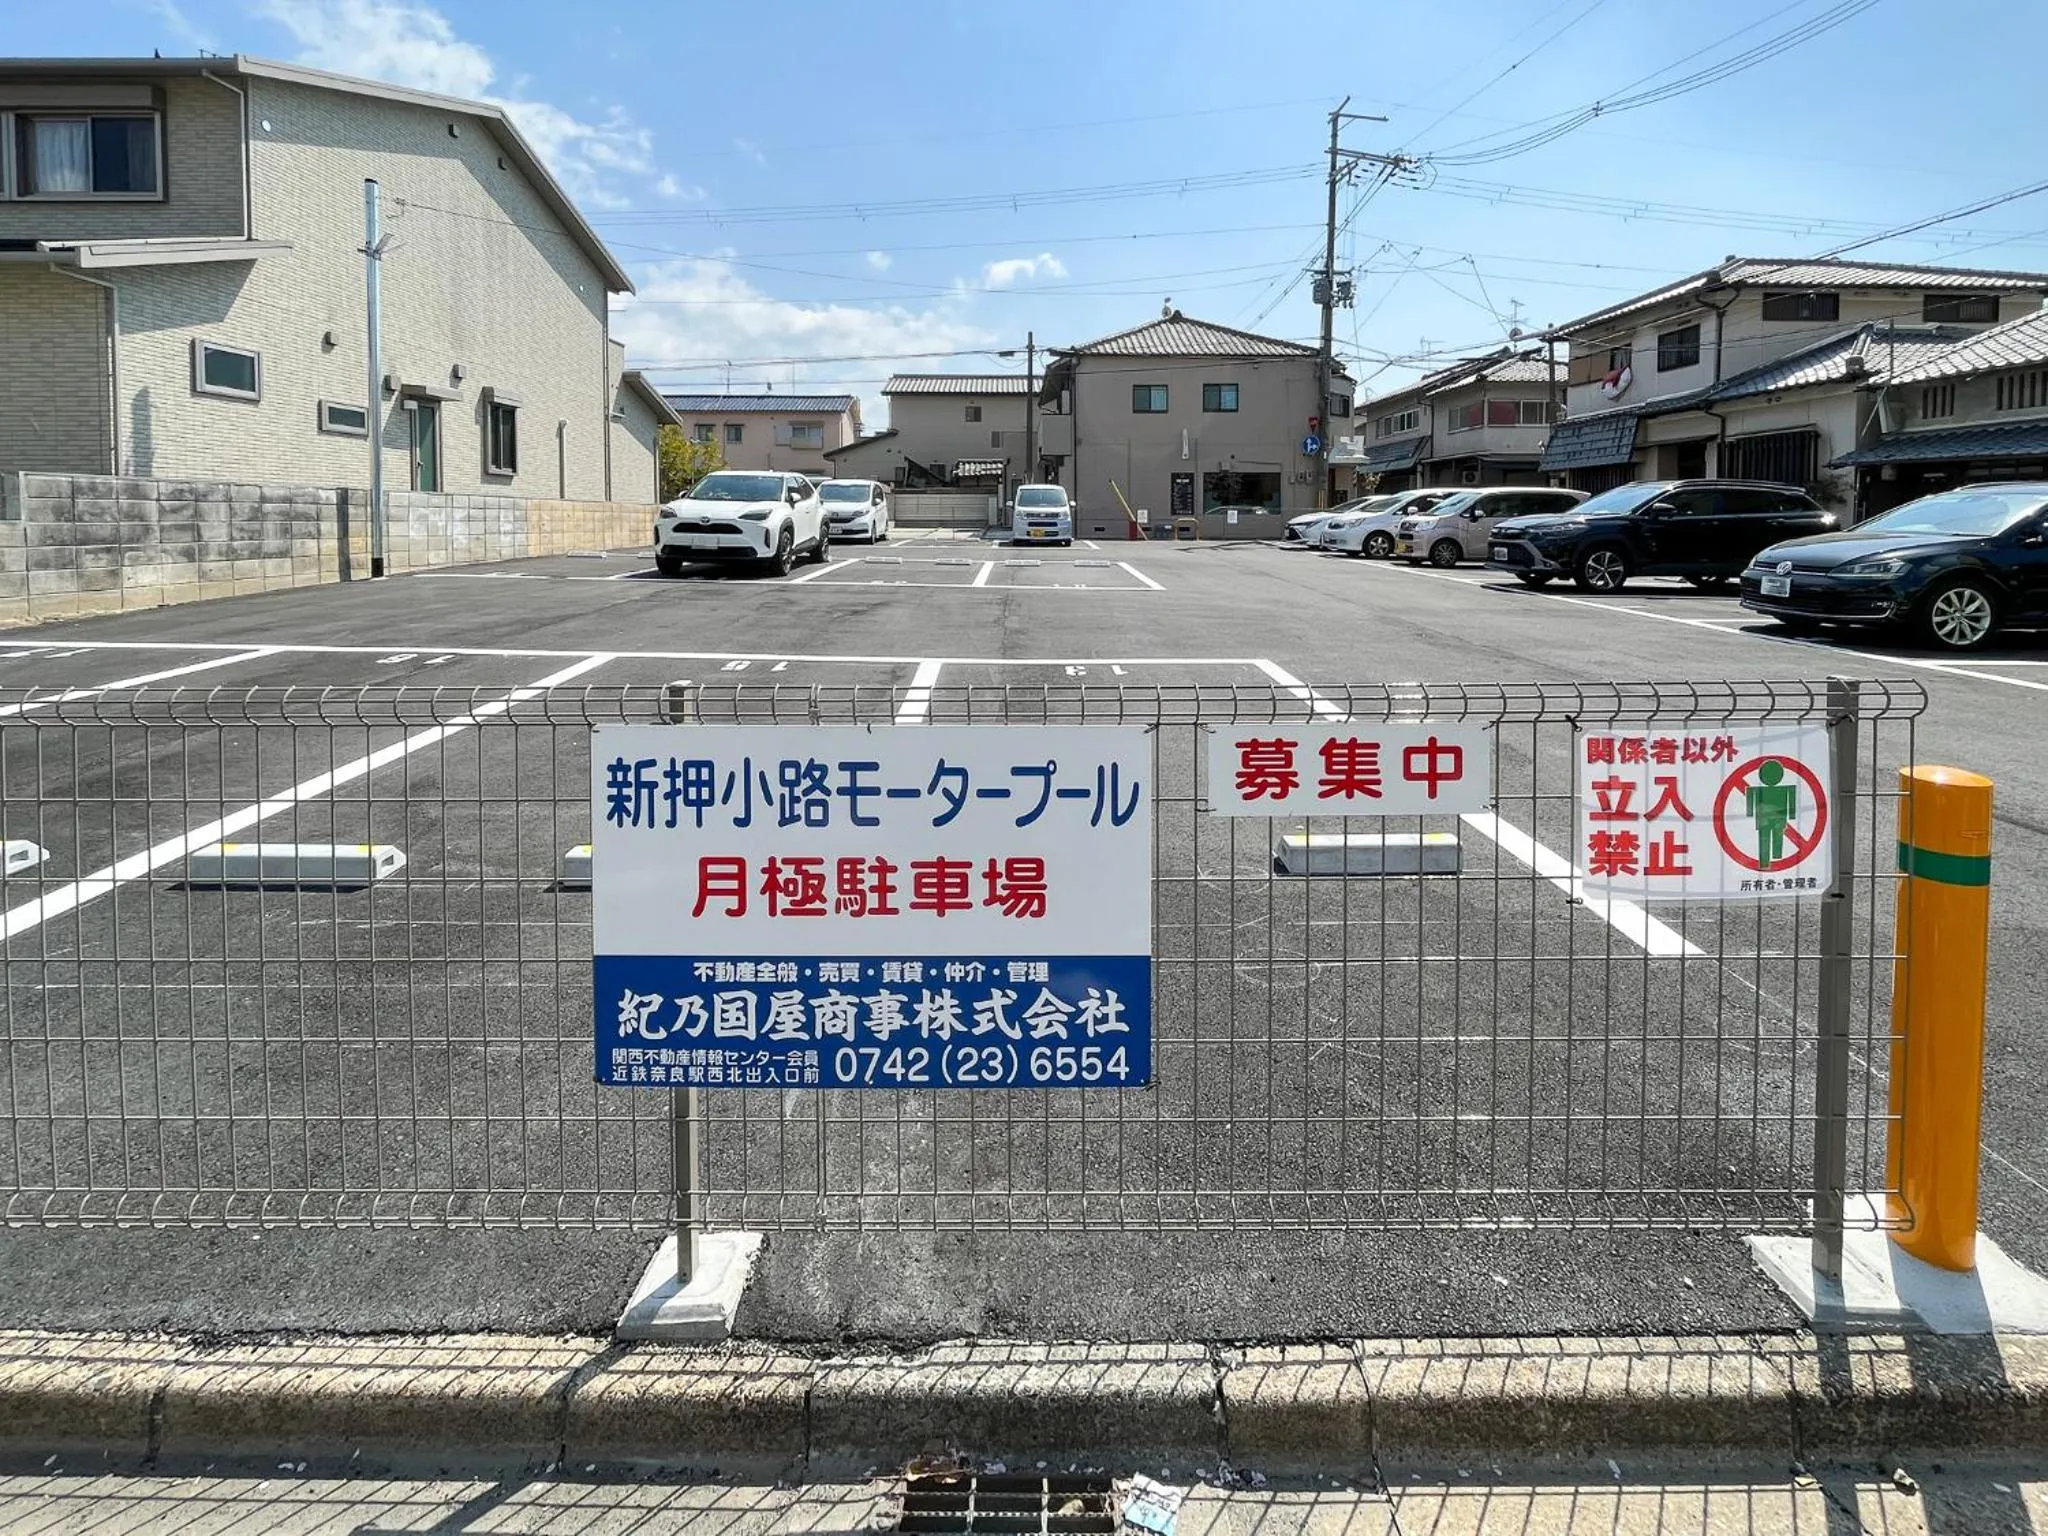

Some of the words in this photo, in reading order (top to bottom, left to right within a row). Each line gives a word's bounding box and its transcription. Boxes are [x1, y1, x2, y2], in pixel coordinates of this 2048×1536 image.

[1234, 736, 1464, 801] 募集中
[1586, 735, 1740, 765] 関係者以外
[606, 757, 1140, 828] 新押小路モータープール
[1589, 775, 1694, 822] 立入
[1588, 830, 1693, 878] 禁止
[692, 856, 1048, 918] 月極駐車場
[618, 986, 1131, 1042] 紀乃国屋商事株式会社
[612, 1048, 819, 1066] 関西不動産情報センター会員
[612, 1066, 820, 1084] 近鉄奈良駅西北出入口前
